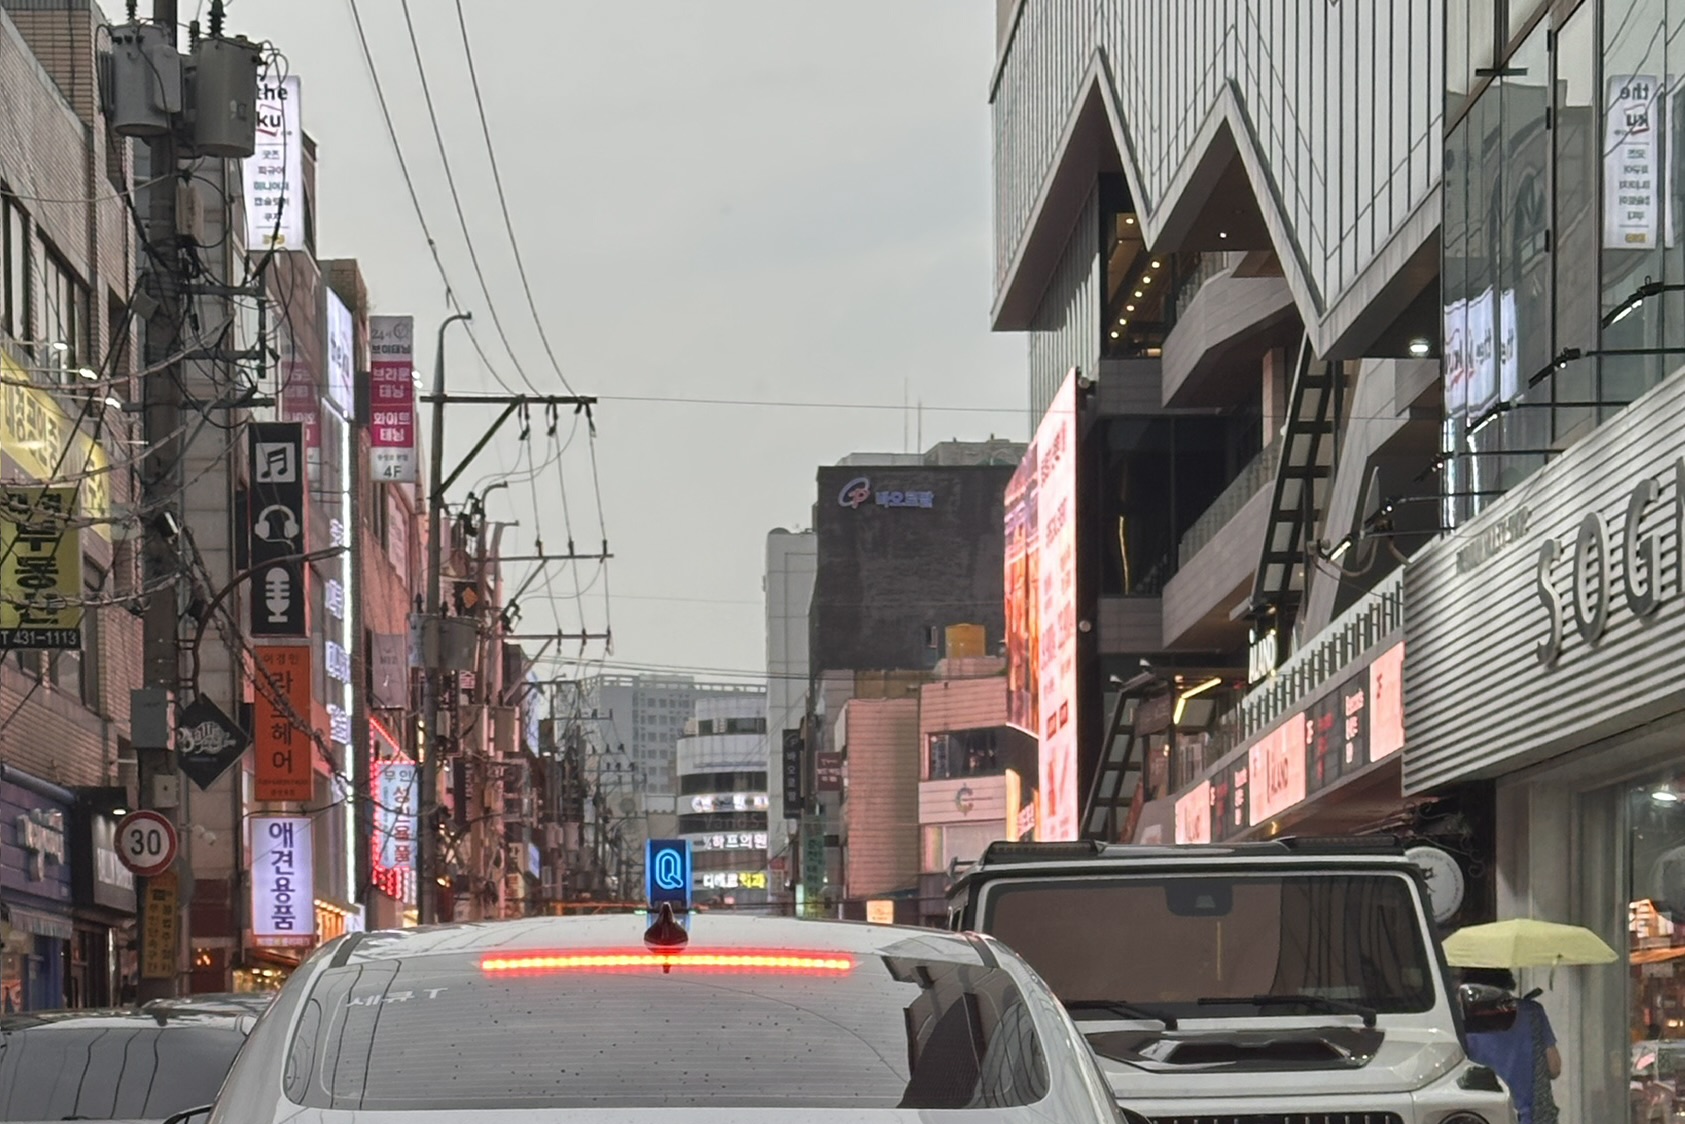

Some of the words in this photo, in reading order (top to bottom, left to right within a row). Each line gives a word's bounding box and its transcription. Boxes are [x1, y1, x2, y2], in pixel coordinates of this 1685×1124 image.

[373, 412, 411, 425] 화이트
[380, 428, 404, 441] 태닝
[383, 465, 402, 478] 4F
[13, 631, 77, 646] 431-1113
[384, 770, 412, 783] 무인
[393, 785, 411, 863] 성인용품
[130, 829, 162, 856] 30
[268, 821, 296, 931] 애견용품
[656, 848, 684, 890] Q
